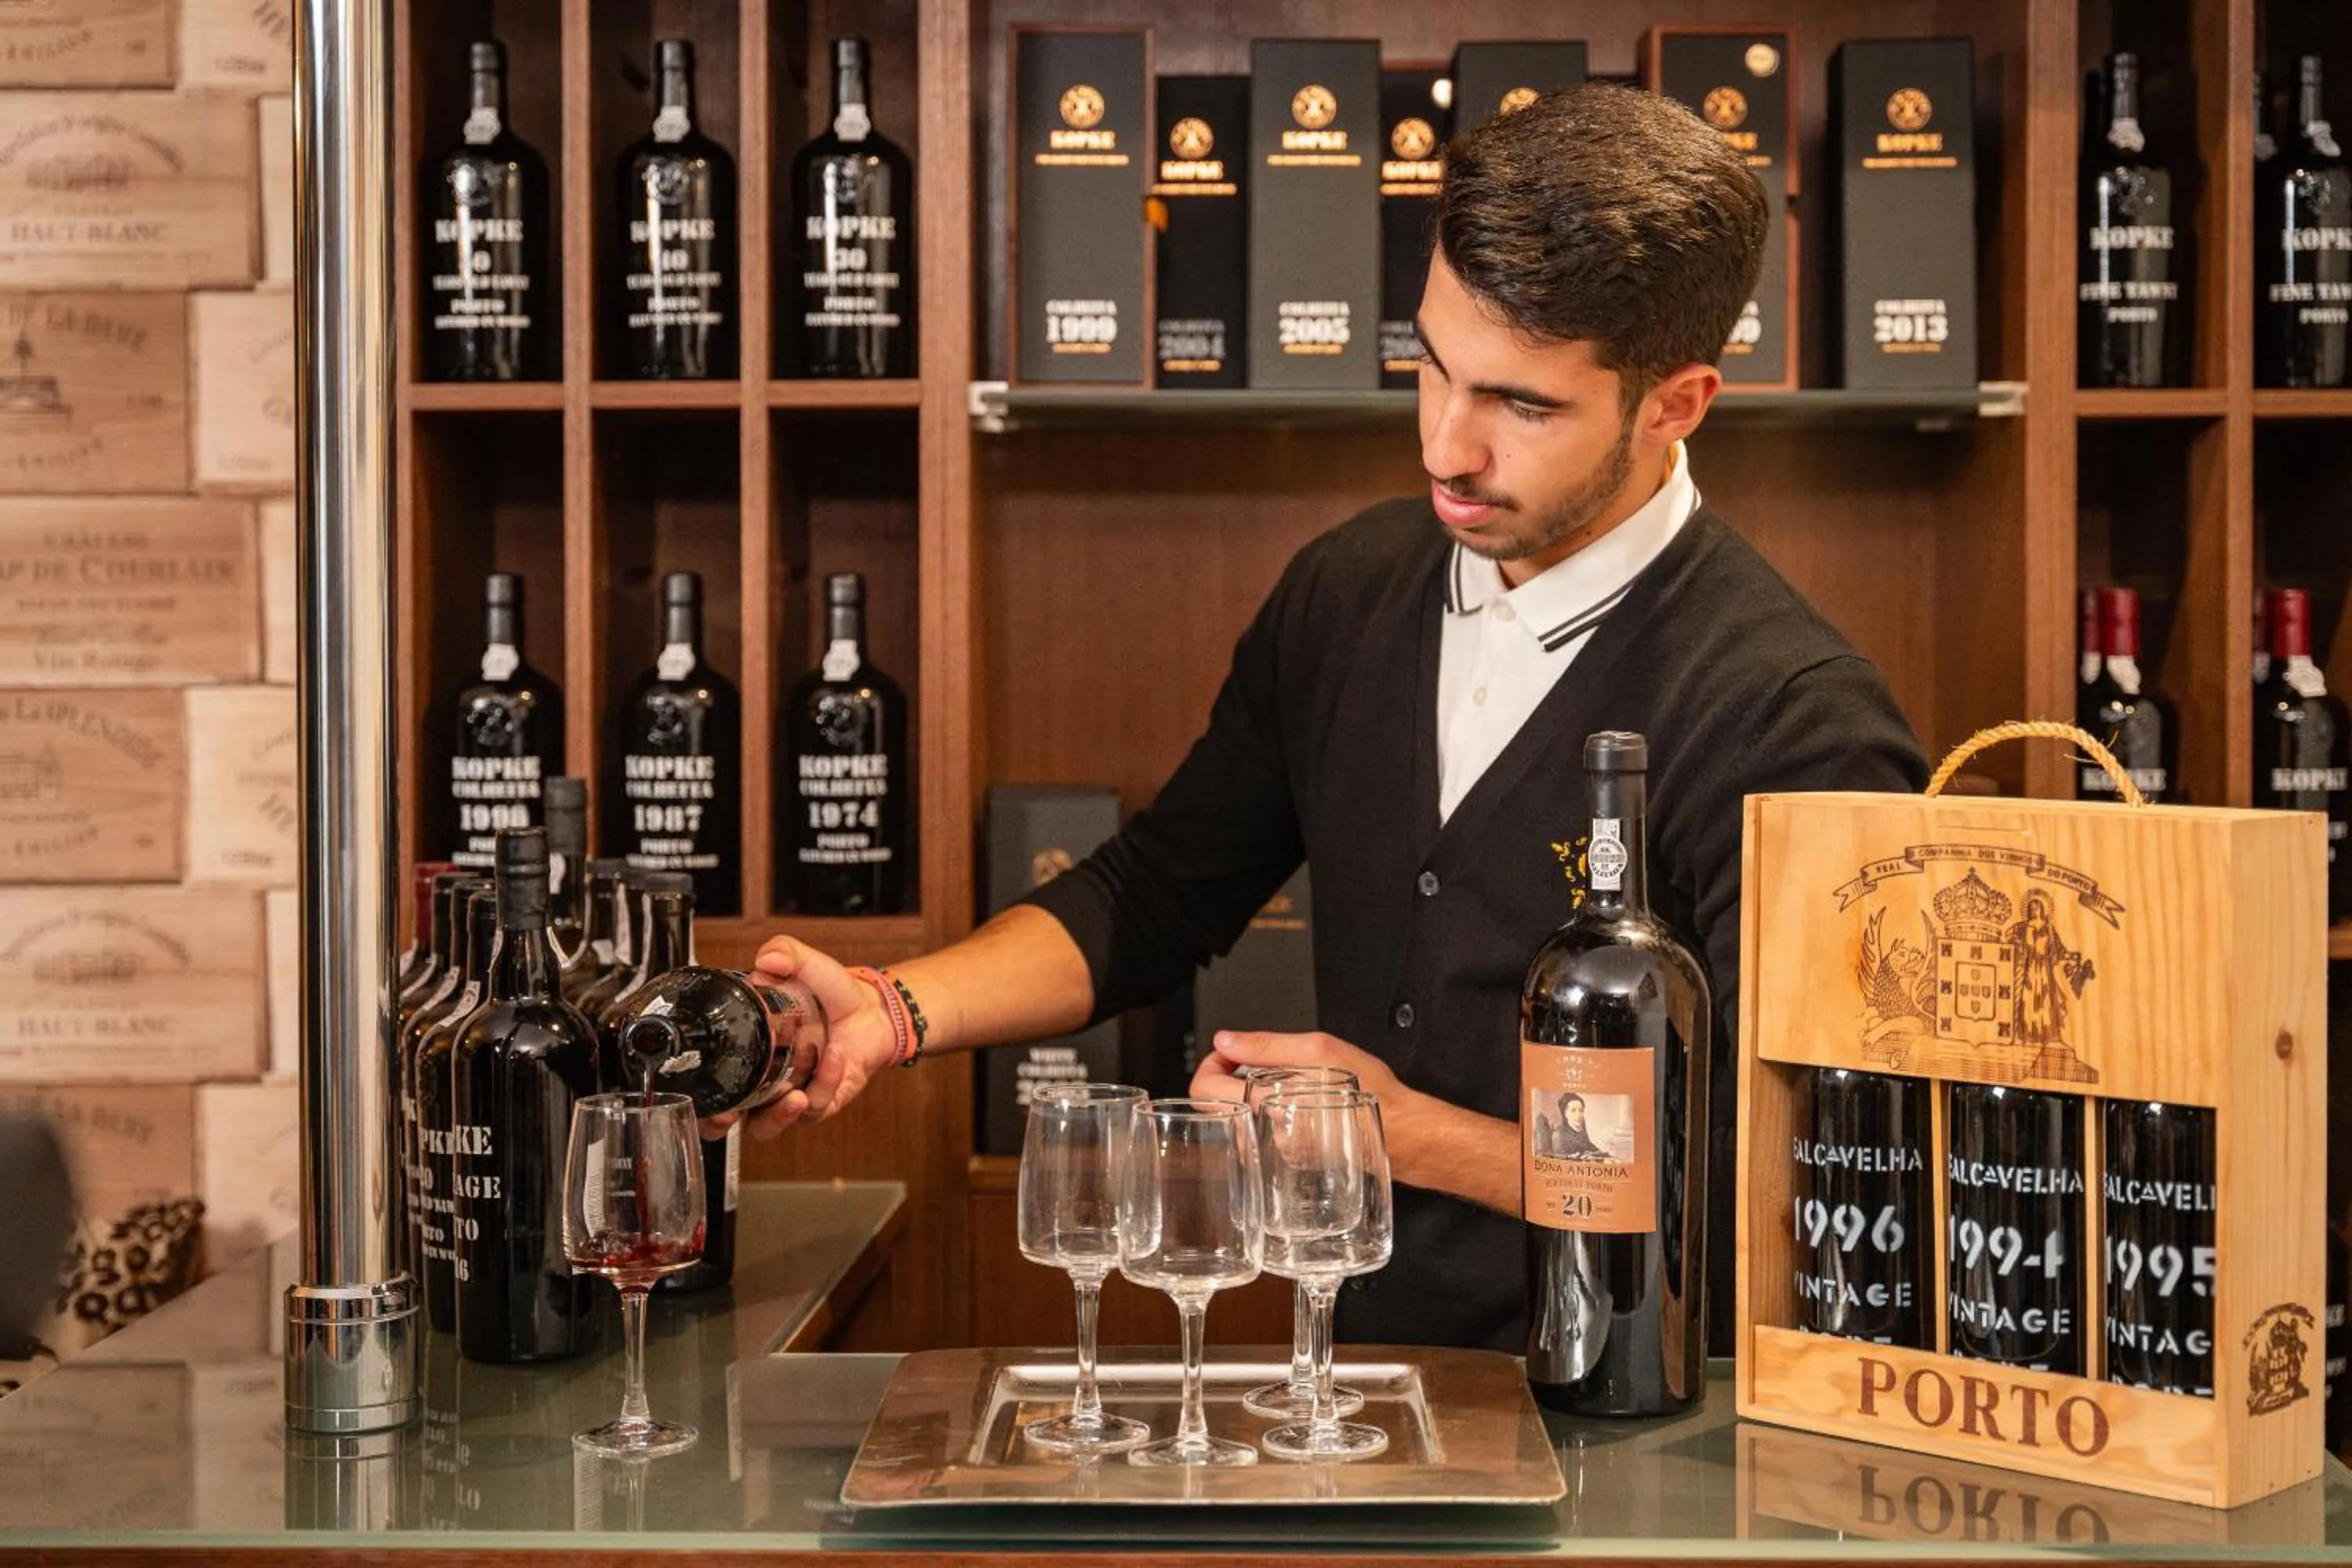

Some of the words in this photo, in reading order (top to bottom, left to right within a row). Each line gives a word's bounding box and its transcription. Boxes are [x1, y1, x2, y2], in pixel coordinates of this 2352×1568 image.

[630, 220, 715, 242] KPKE
[2089, 226, 2173, 249] KOPKE
[2282, 227, 2352, 250] KOPK
[2270, 283, 2313, 301] FINE
[2316, 283, 2352, 301] TAW
[1875, 315, 1948, 342] 2013
[626, 755, 714, 779] KOPKE
[799, 754, 887, 778] KOPKE
[2082, 768, 2165, 790] KOKE
[634, 804, 703, 832] 1987
[808, 801, 879, 828] 1974
[1876, 862, 1901, 874] REAL
[1533, 1160, 1563, 1174] DONA
[1562, 1193, 1592, 1218] 20
[1795, 1195, 1905, 1254] 1996
[1949, 1214, 2066, 1279] 1994
[2105, 1235, 2216, 1297] 1995
[2105, 1316, 2212, 1356] INTAG
[1857, 1357, 2110, 1457] PORTO
